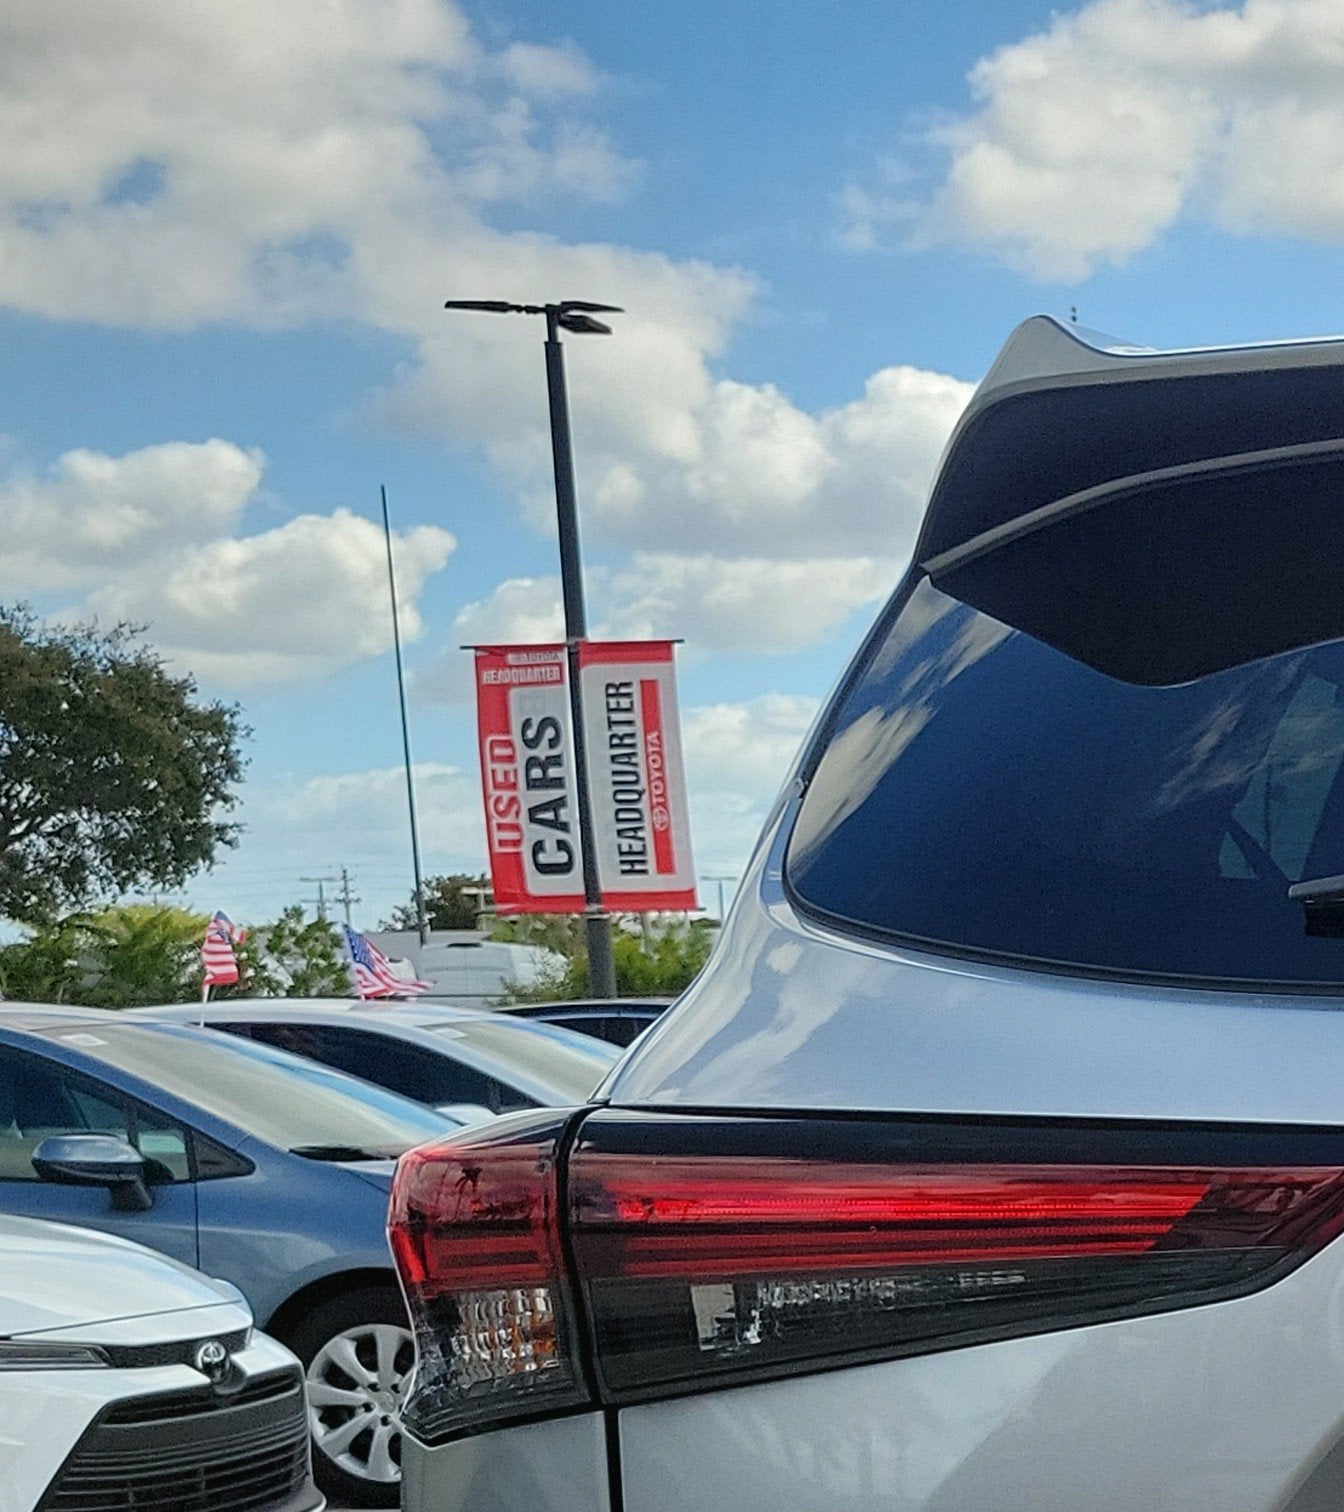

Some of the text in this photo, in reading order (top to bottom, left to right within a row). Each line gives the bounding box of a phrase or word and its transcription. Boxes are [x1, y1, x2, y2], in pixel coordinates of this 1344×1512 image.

[486, 737, 524, 853] USED
[521, 715, 574, 876] CARS
[605, 680, 649, 876] HEADQUARTER
[646, 731, 669, 806] TOYOTA
